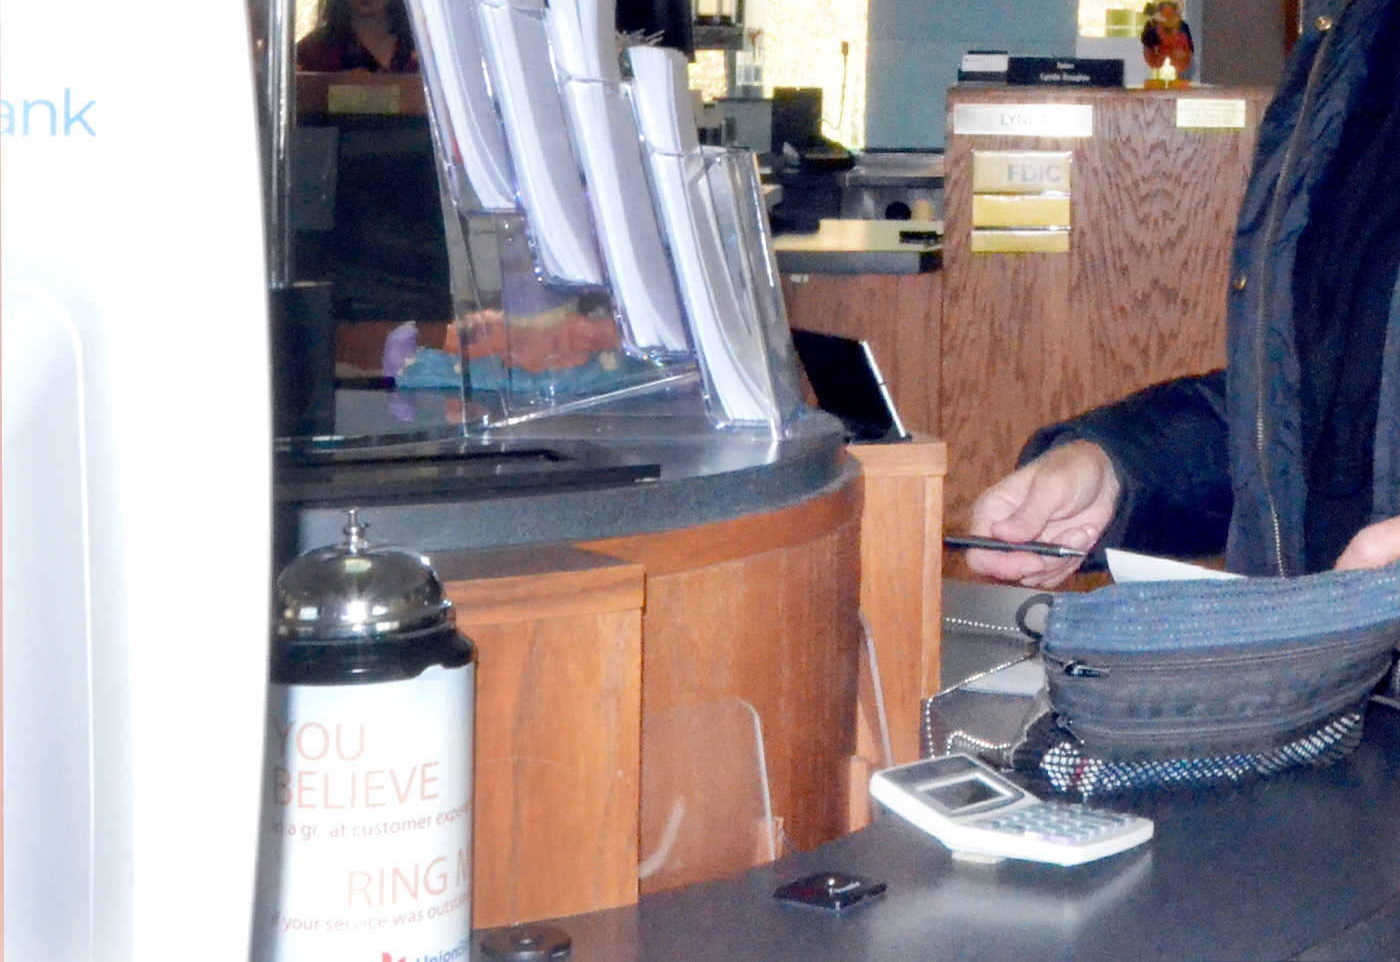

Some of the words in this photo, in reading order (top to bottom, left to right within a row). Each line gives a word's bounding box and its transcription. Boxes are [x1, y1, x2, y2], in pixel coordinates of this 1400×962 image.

[1006, 164, 1062, 183] FDIC
[272, 761, 439, 810] BELIEVE
[352, 815, 433, 837] customer
[347, 855, 449, 907] RING
[282, 916, 320, 933] your
[325, 916, 388, 932] service
[393, 907, 424, 926] was
